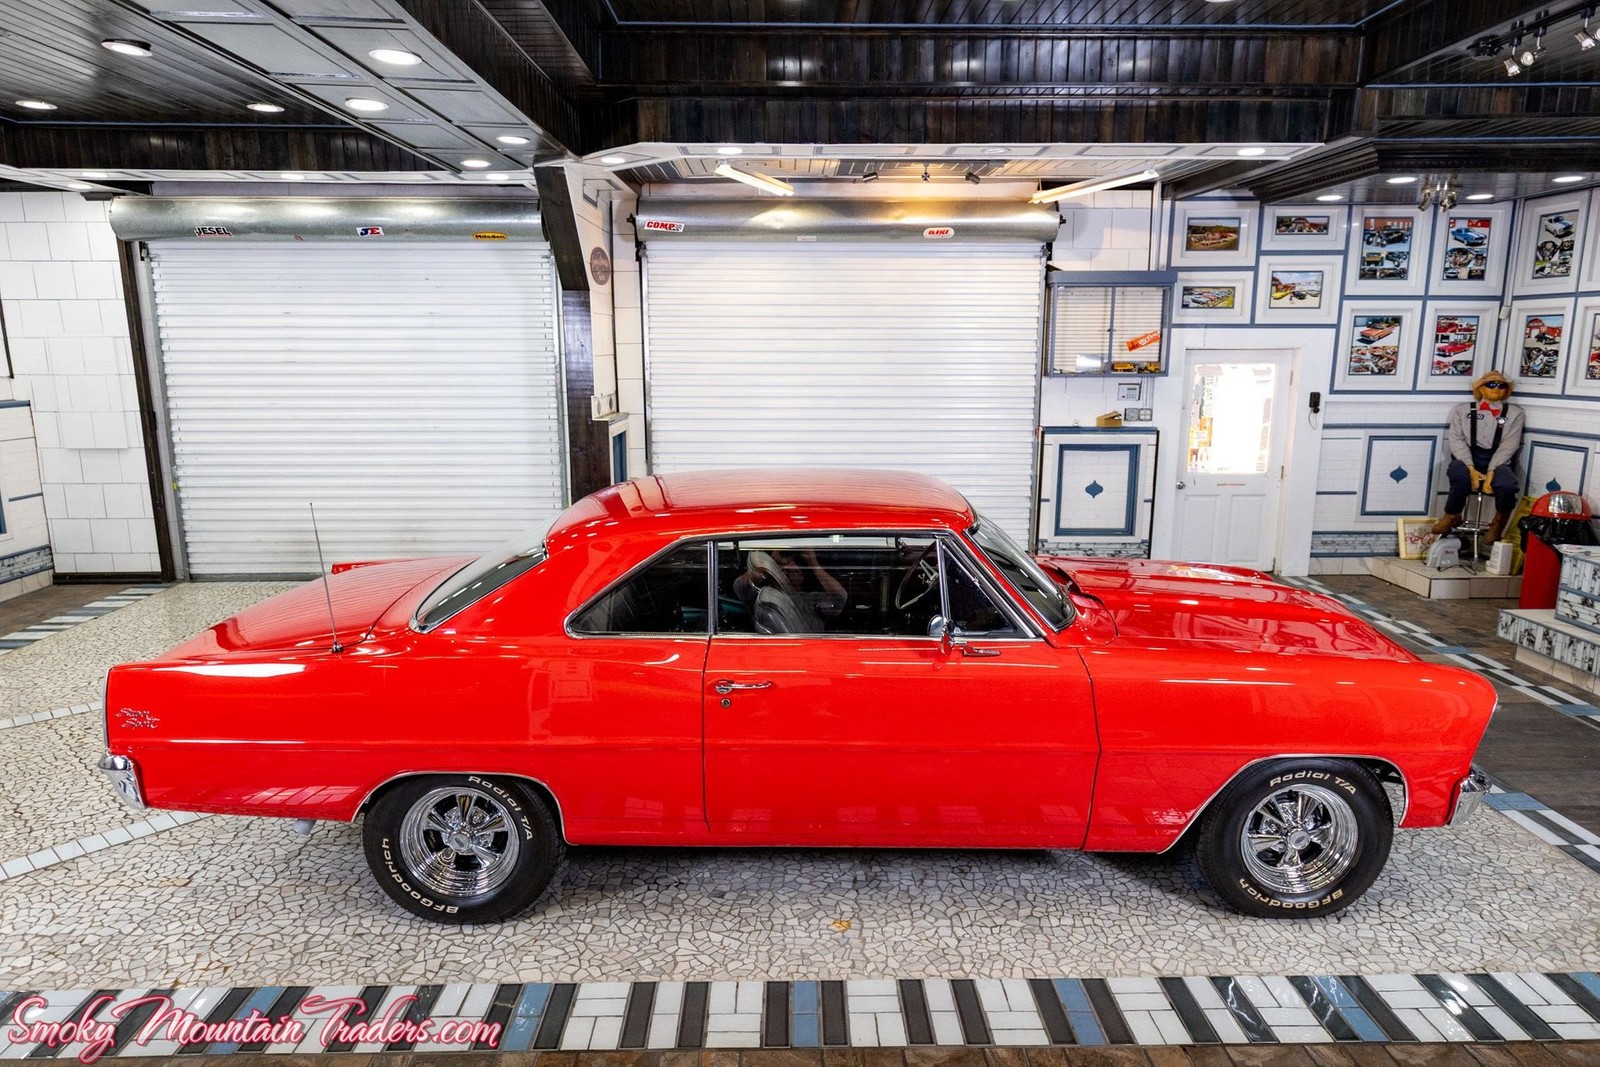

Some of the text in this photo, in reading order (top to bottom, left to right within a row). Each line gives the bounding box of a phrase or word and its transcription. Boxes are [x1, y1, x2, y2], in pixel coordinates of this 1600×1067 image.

[195, 226, 232, 236] JESEL
[646, 221, 676, 230] COMP
[1269, 770, 1358, 795] Radial T/A
[468, 775, 533, 841] Radial T/A
[382, 838, 460, 914] BFGoodrich
[1239, 878, 1344, 909] BFGoodrich
